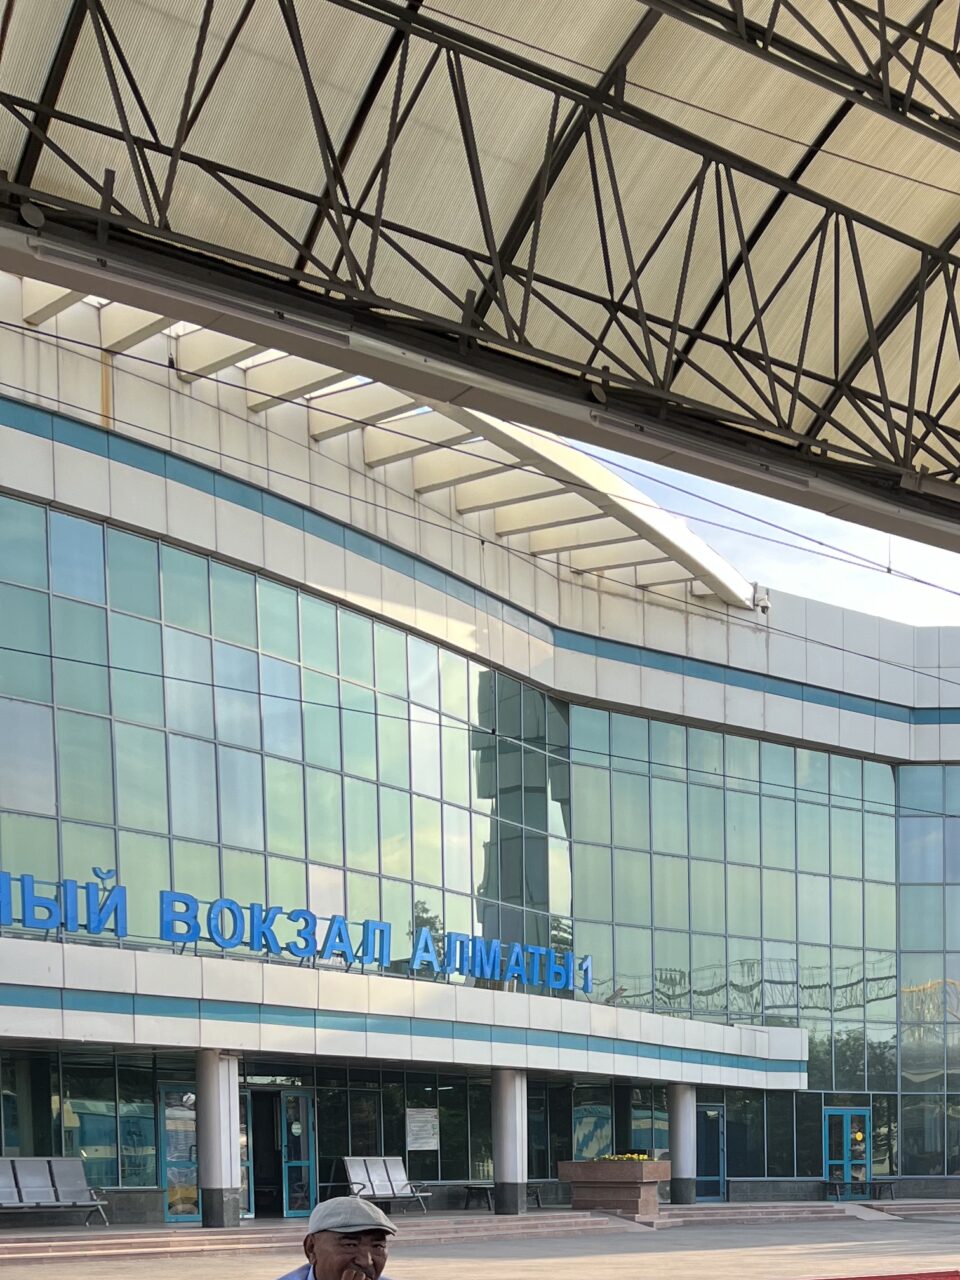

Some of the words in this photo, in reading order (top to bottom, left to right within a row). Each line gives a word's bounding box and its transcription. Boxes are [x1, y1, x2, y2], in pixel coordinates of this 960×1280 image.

[0, 866, 127, 938] ЫЙ
[159, 890, 392, 968] ВОКЗАЛ
[409, 927, 575, 991] АЛМАТЫ
[579, 954, 593, 993] 1
